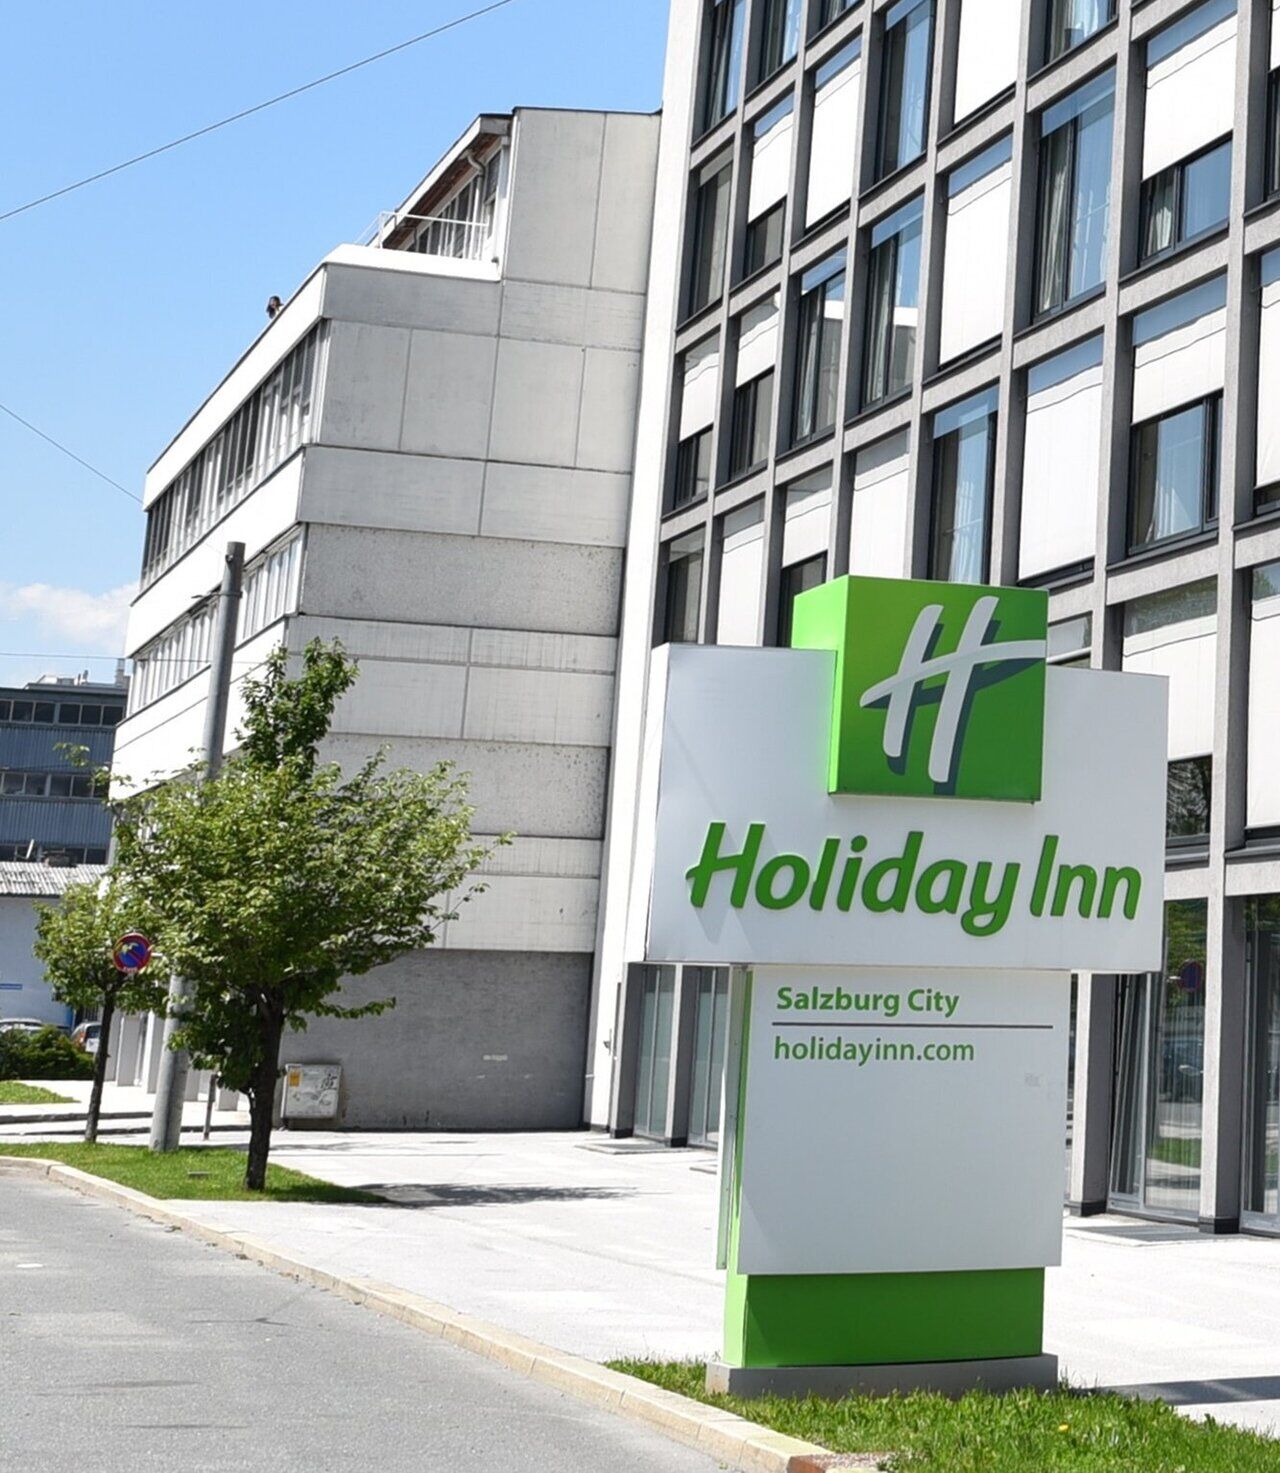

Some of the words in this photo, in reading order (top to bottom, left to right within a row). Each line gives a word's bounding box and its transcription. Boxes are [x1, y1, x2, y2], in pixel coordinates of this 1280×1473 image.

[685, 822, 1021, 937] Holiday
[1029, 834, 1142, 920] Inn
[776, 986, 900, 1018] Salzburg
[907, 988, 960, 1018] City
[774, 1036, 975, 1067] holidayinn.com
